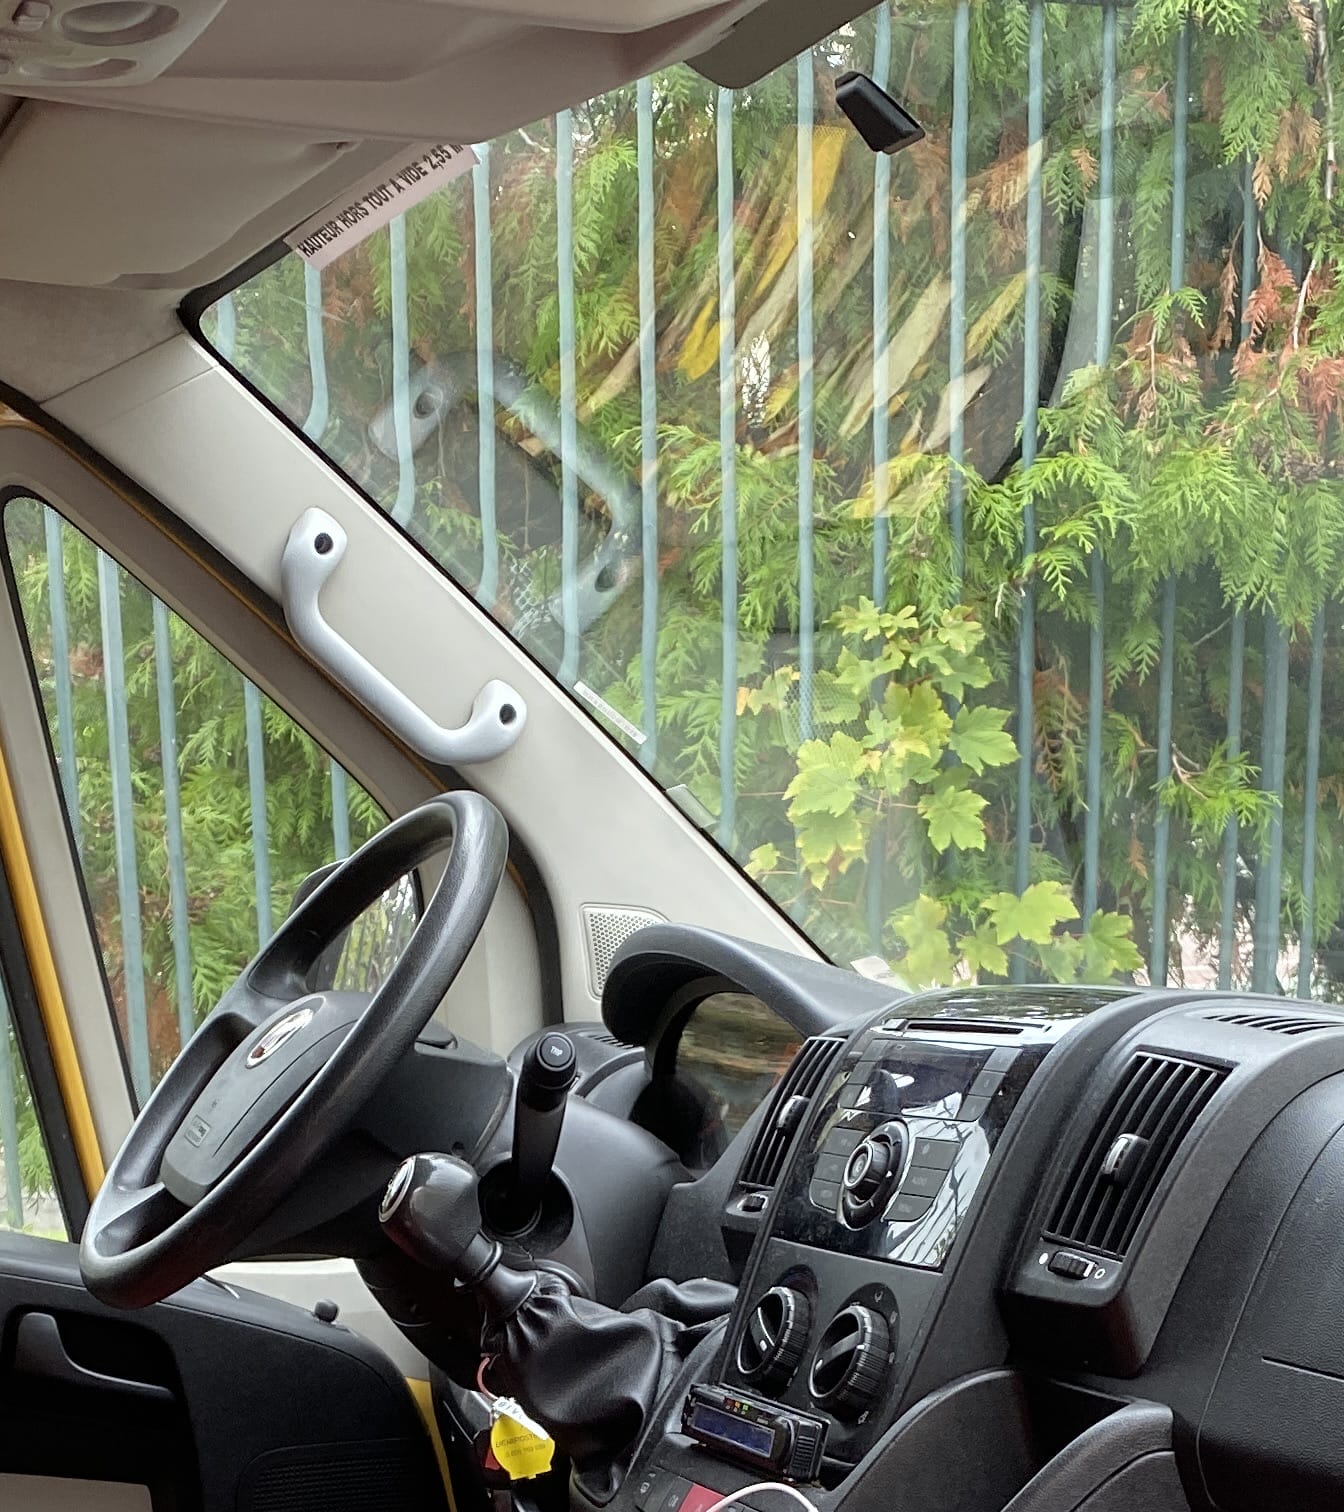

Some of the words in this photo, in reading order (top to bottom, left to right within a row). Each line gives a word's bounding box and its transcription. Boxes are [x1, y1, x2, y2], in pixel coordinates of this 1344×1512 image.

[296, 221, 344, 258] HAUTEUR
[338, 202, 370, 229] HORS
[362, 183, 395, 210] TOUT
[388, 177, 405, 194] A
[399, 161, 429, 186] VIDE
[422, 144, 453, 170] 2,55
